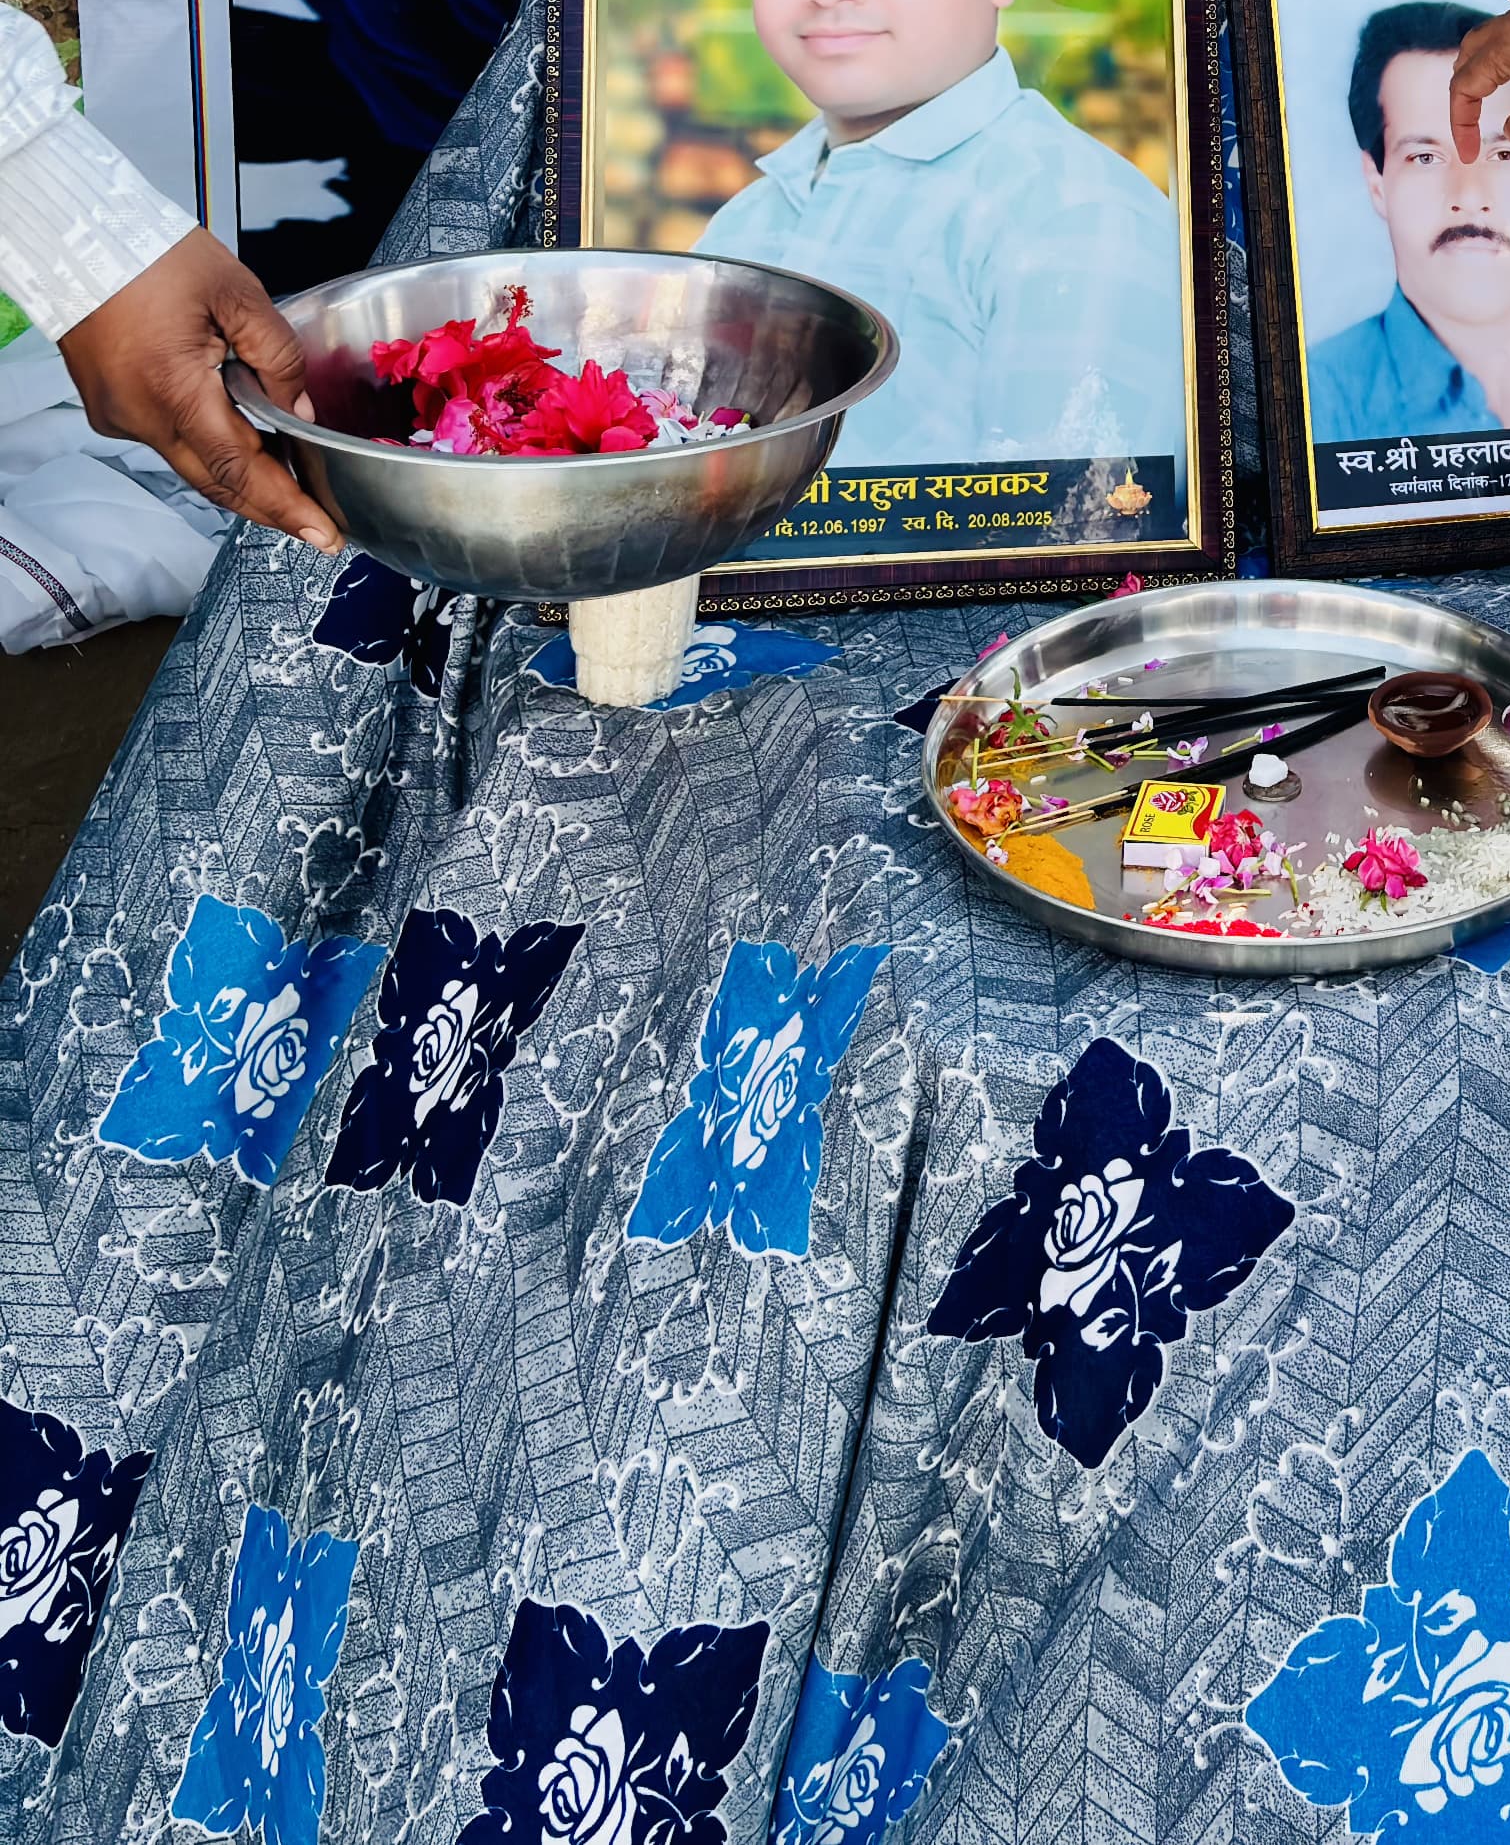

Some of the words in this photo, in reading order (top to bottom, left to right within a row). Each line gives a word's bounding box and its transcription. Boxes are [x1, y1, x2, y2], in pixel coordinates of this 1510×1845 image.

[838, 477, 919, 511] राहुल
[924, 471, 1050, 499] सरनकर
[1388, 474, 1443, 497] स्वर्गवास
[967, 510, 1053, 529] 20.08.2025
[1139, 813, 1156, 834] ROSE
